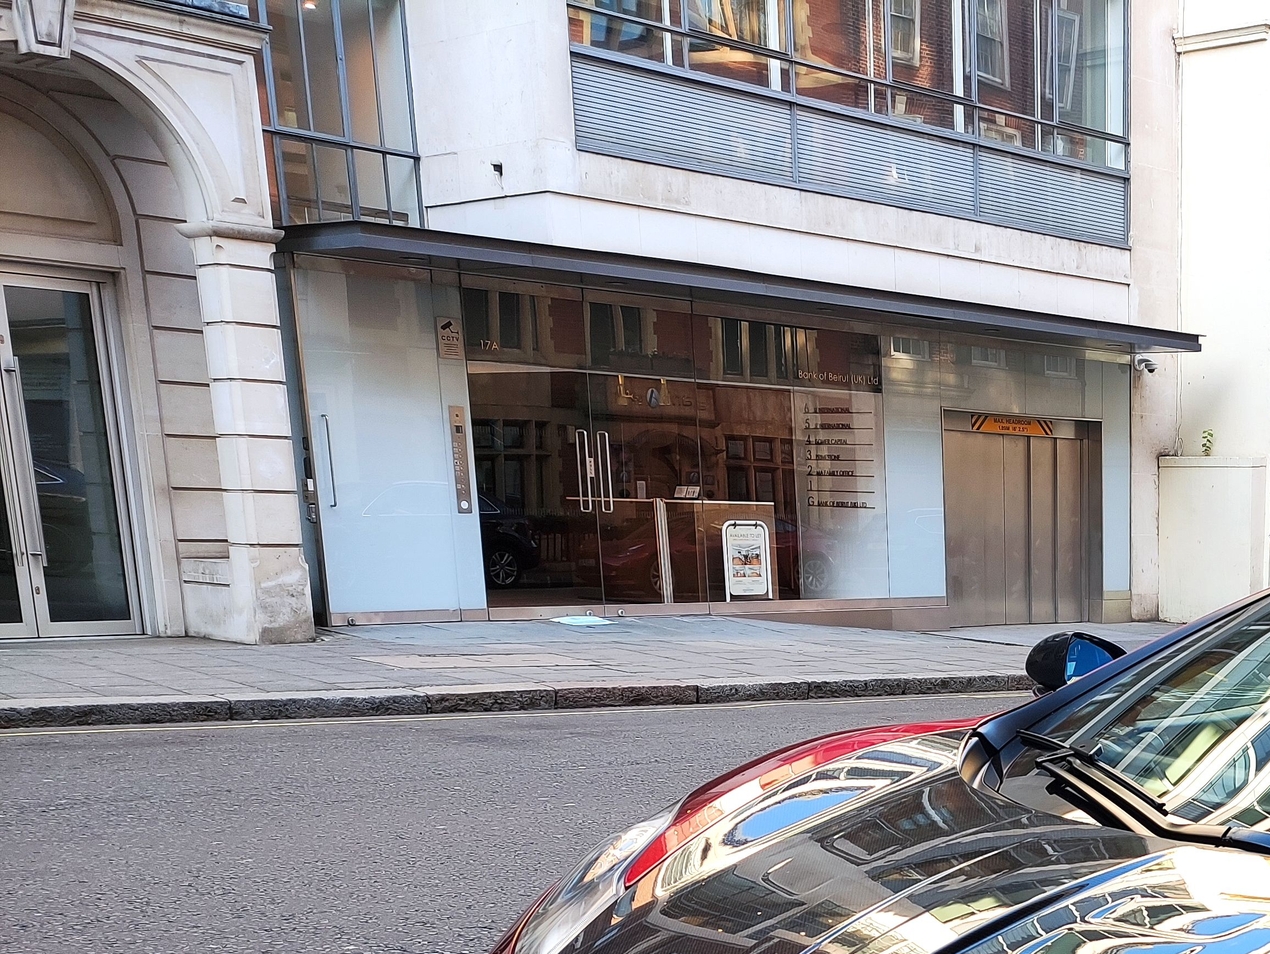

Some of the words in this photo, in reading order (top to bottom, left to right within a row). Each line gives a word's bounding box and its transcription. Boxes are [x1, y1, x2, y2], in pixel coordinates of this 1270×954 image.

[480, 339, 500, 351] 17A
[798, 369, 818, 380] Bank
[818, 371, 827, 381] of
[828, 372, 849, 383] Beirut
[850, 373, 866, 386] (UK)
[867, 375, 879, 385] Ltd
[805, 418, 811, 429] 5
[806, 449, 812, 460] 3
[807, 465, 813, 476] 2
[807, 496, 814, 507] G
